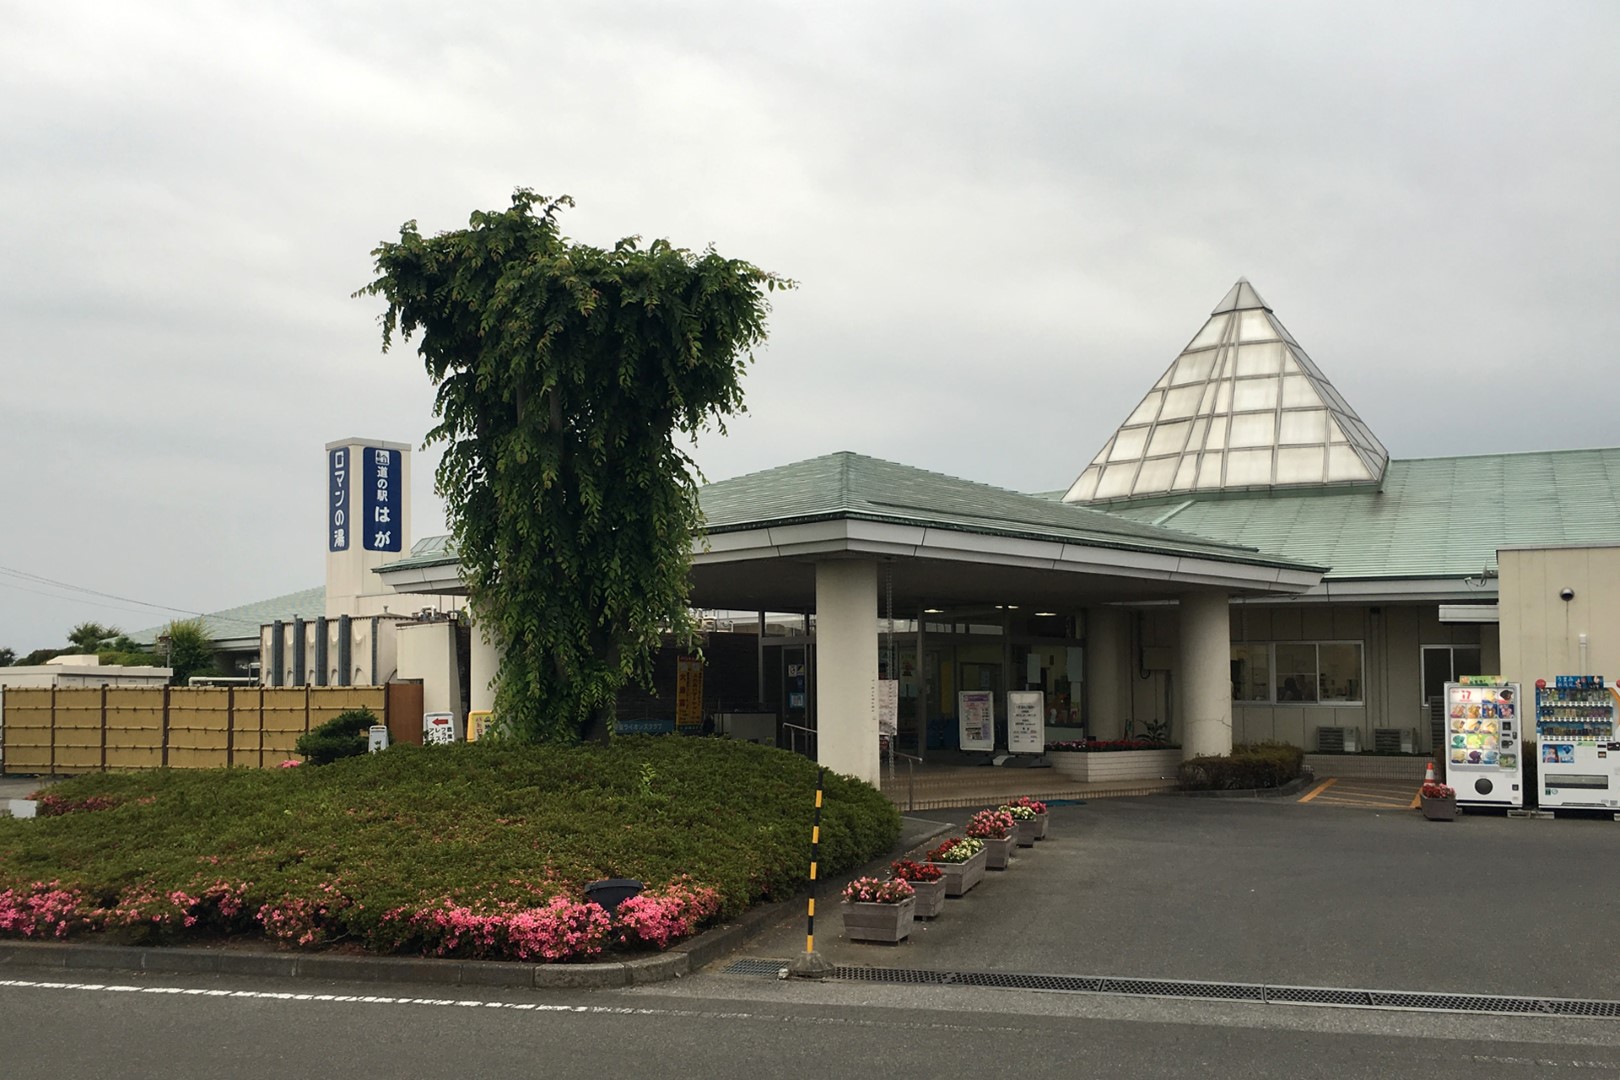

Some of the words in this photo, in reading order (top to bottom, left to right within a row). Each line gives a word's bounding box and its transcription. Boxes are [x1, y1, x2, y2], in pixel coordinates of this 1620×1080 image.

[334, 451, 344, 548] ロマンの湯
[374, 466, 391, 548] 道の駅はが
